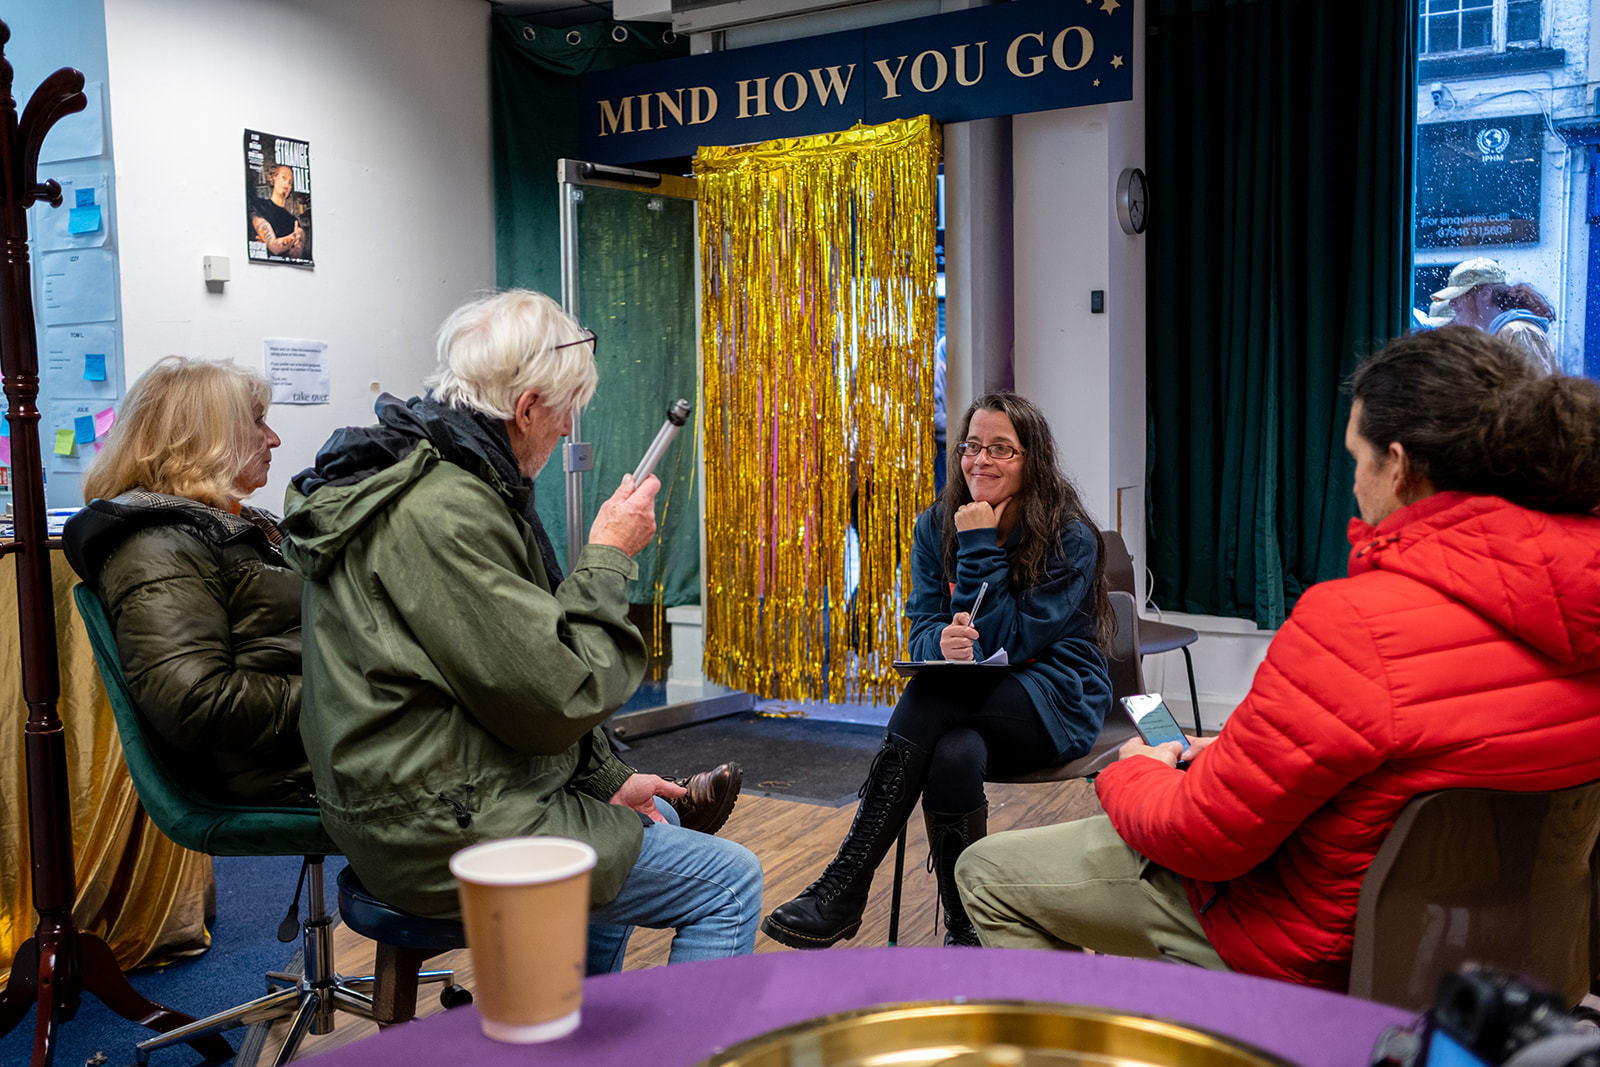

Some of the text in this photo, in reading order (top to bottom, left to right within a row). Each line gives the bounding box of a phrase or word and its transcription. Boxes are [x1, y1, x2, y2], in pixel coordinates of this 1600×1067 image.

[597, 26, 1095, 136] MIND HOW YOU GO
[275, 138, 309, 168] STRANGE
[1482, 154, 1504, 162] IPHM
[292, 167, 310, 194] TALE
[1421, 216, 1438, 226] For
[1440, 213, 1487, 226] enquiries
[293, 391, 329, 402] take over
